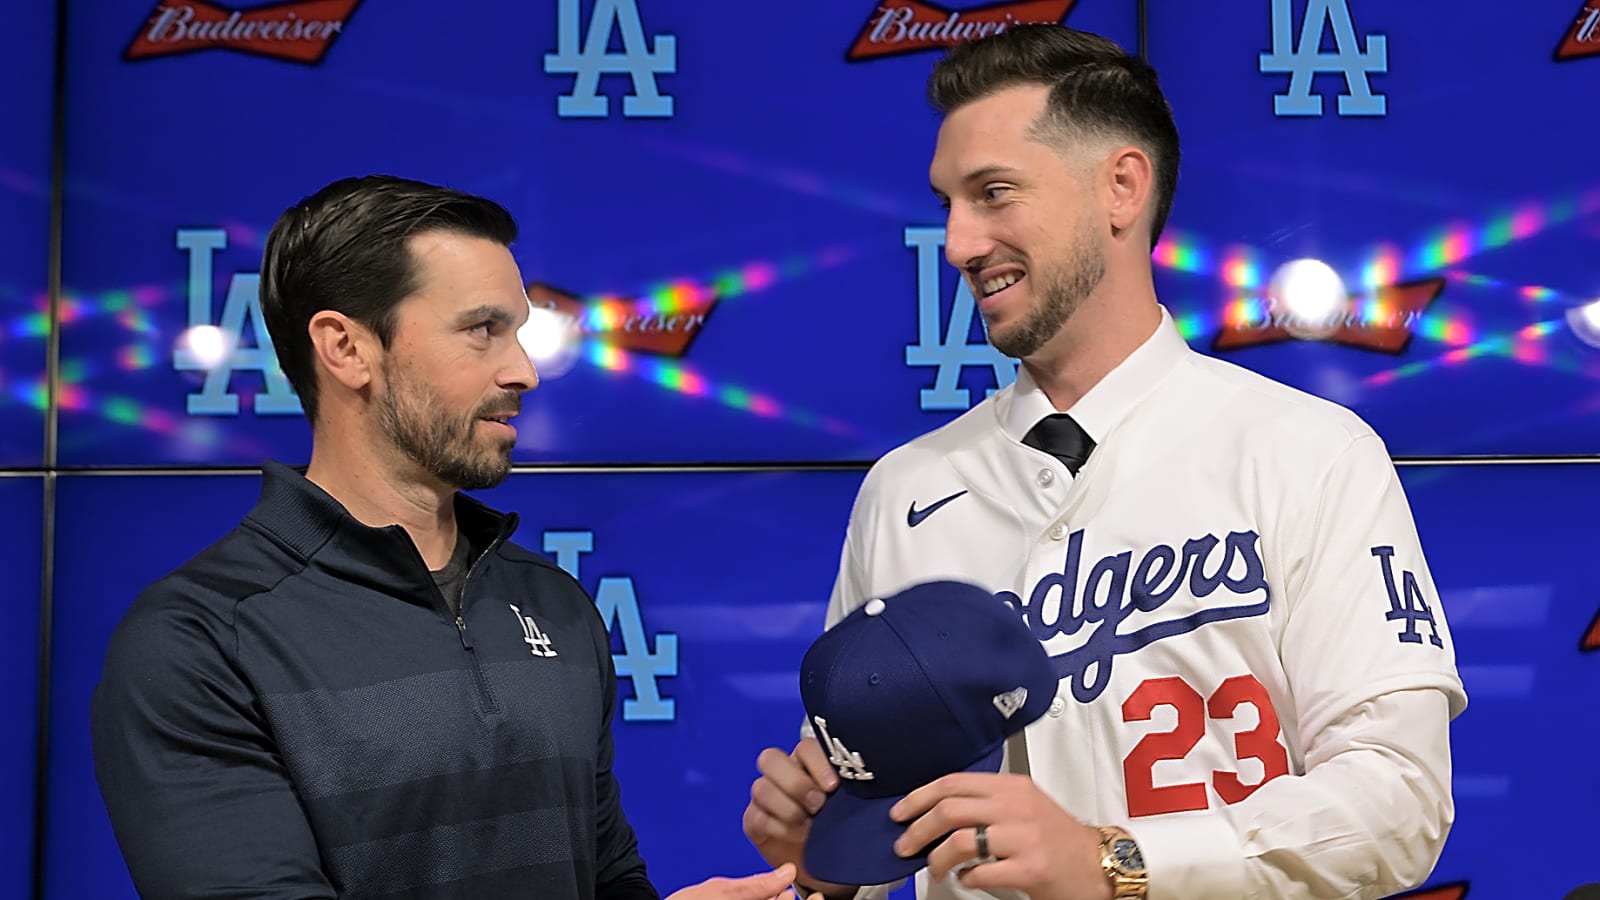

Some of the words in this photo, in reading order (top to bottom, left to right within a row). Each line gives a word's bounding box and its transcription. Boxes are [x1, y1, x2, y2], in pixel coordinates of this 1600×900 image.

[147, 5, 342, 42] Budweiser
[544, 0, 676, 117] LA
[869, 6, 1058, 43] Budwei
[1259, 0, 1388, 115] LA
[173, 229, 304, 415] LA
[509, 604, 558, 657] LA
[994, 528, 1270, 703] dgers
[1370, 545, 1444, 650] LA
[814, 715, 875, 780] LA
[1121, 674, 1290, 818] 23
